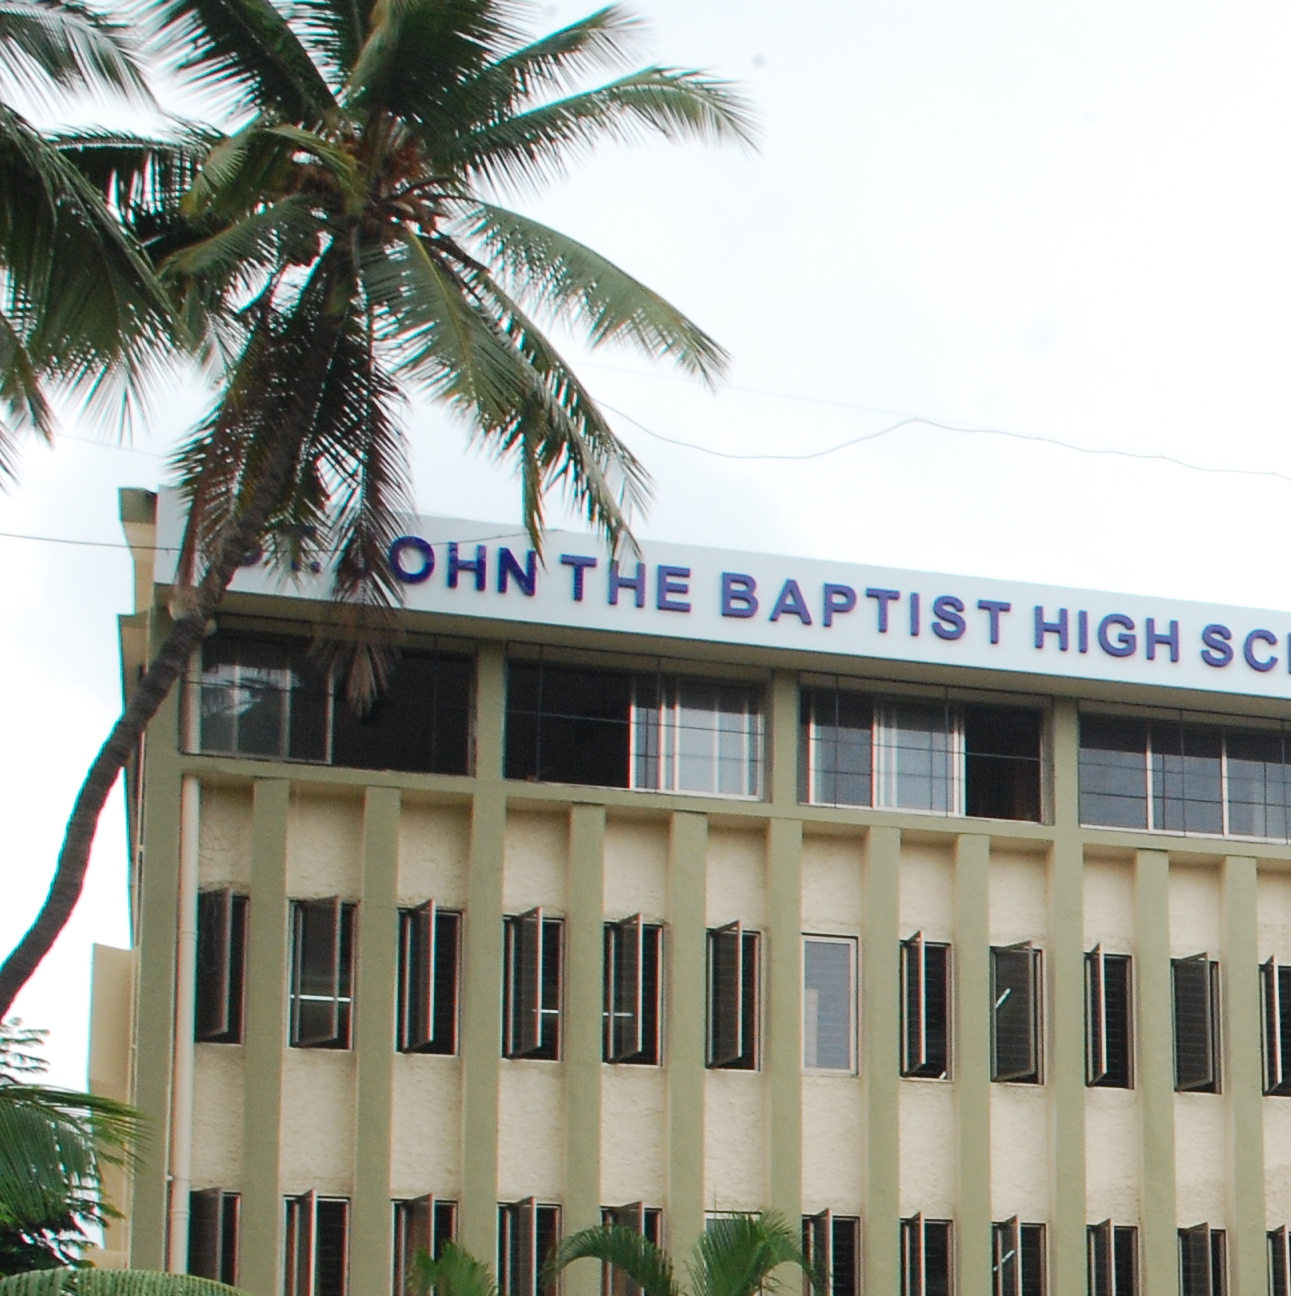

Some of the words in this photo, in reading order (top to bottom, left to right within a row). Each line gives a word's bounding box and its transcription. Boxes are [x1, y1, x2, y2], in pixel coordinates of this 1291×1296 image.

[354, 533, 537, 597] OHN
[560, 554, 692, 613] THE
[721, 572, 1011, 645] BAPTIST
[1034, 605, 1179, 662] HIGH
